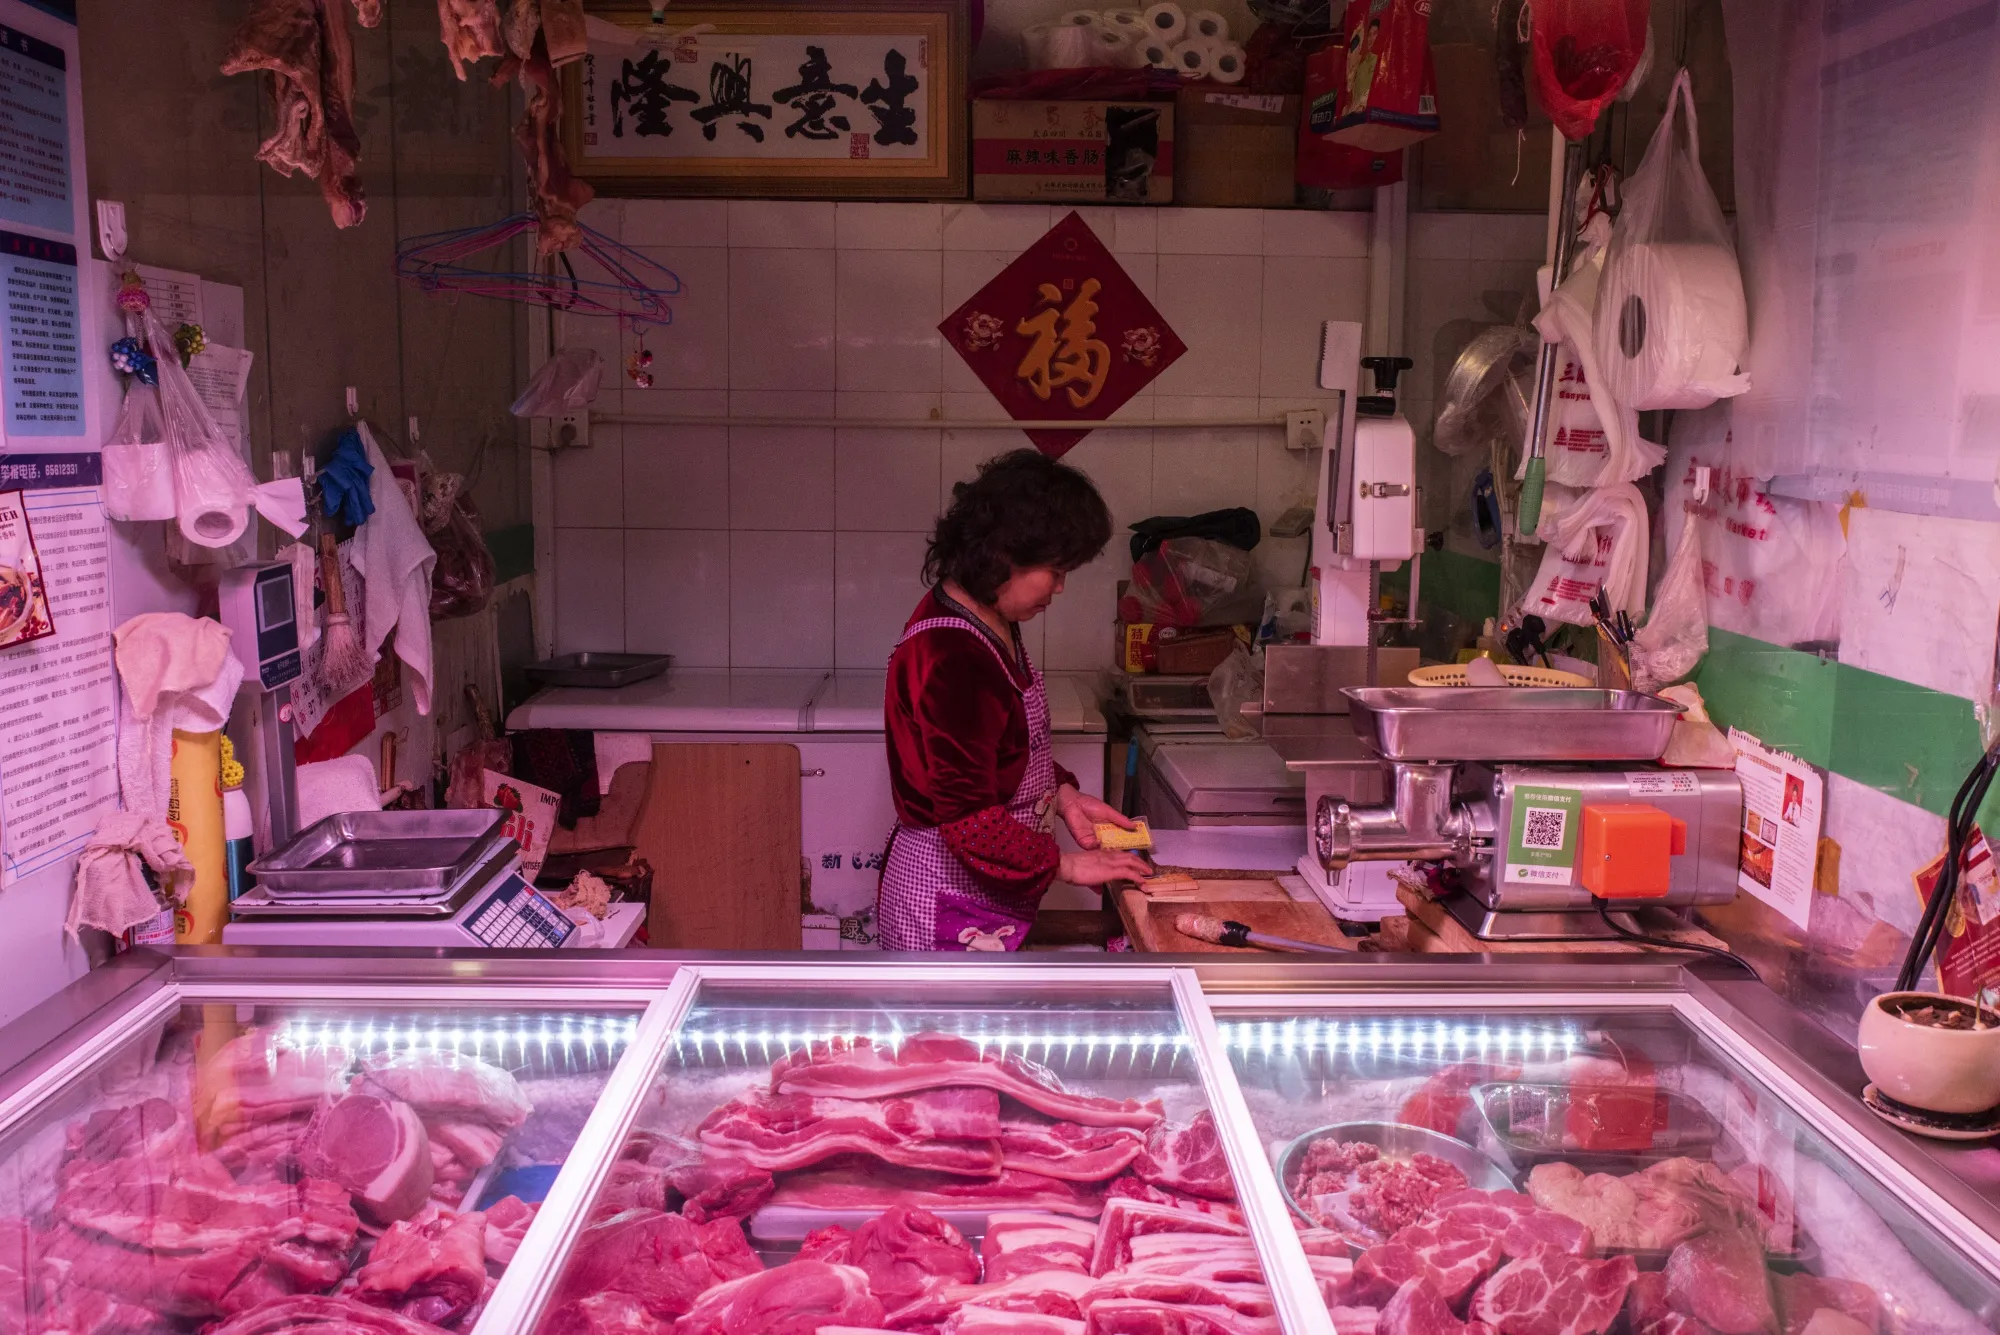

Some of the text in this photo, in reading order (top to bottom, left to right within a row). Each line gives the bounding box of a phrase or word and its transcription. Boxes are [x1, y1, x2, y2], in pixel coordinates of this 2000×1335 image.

[1006, 148, 1106, 166] 麻辣味香肠
[1016, 278, 1111, 409] 福
[45, 463, 78, 476] 65612331
[1530, 869, 1560, 879] 微信支付
